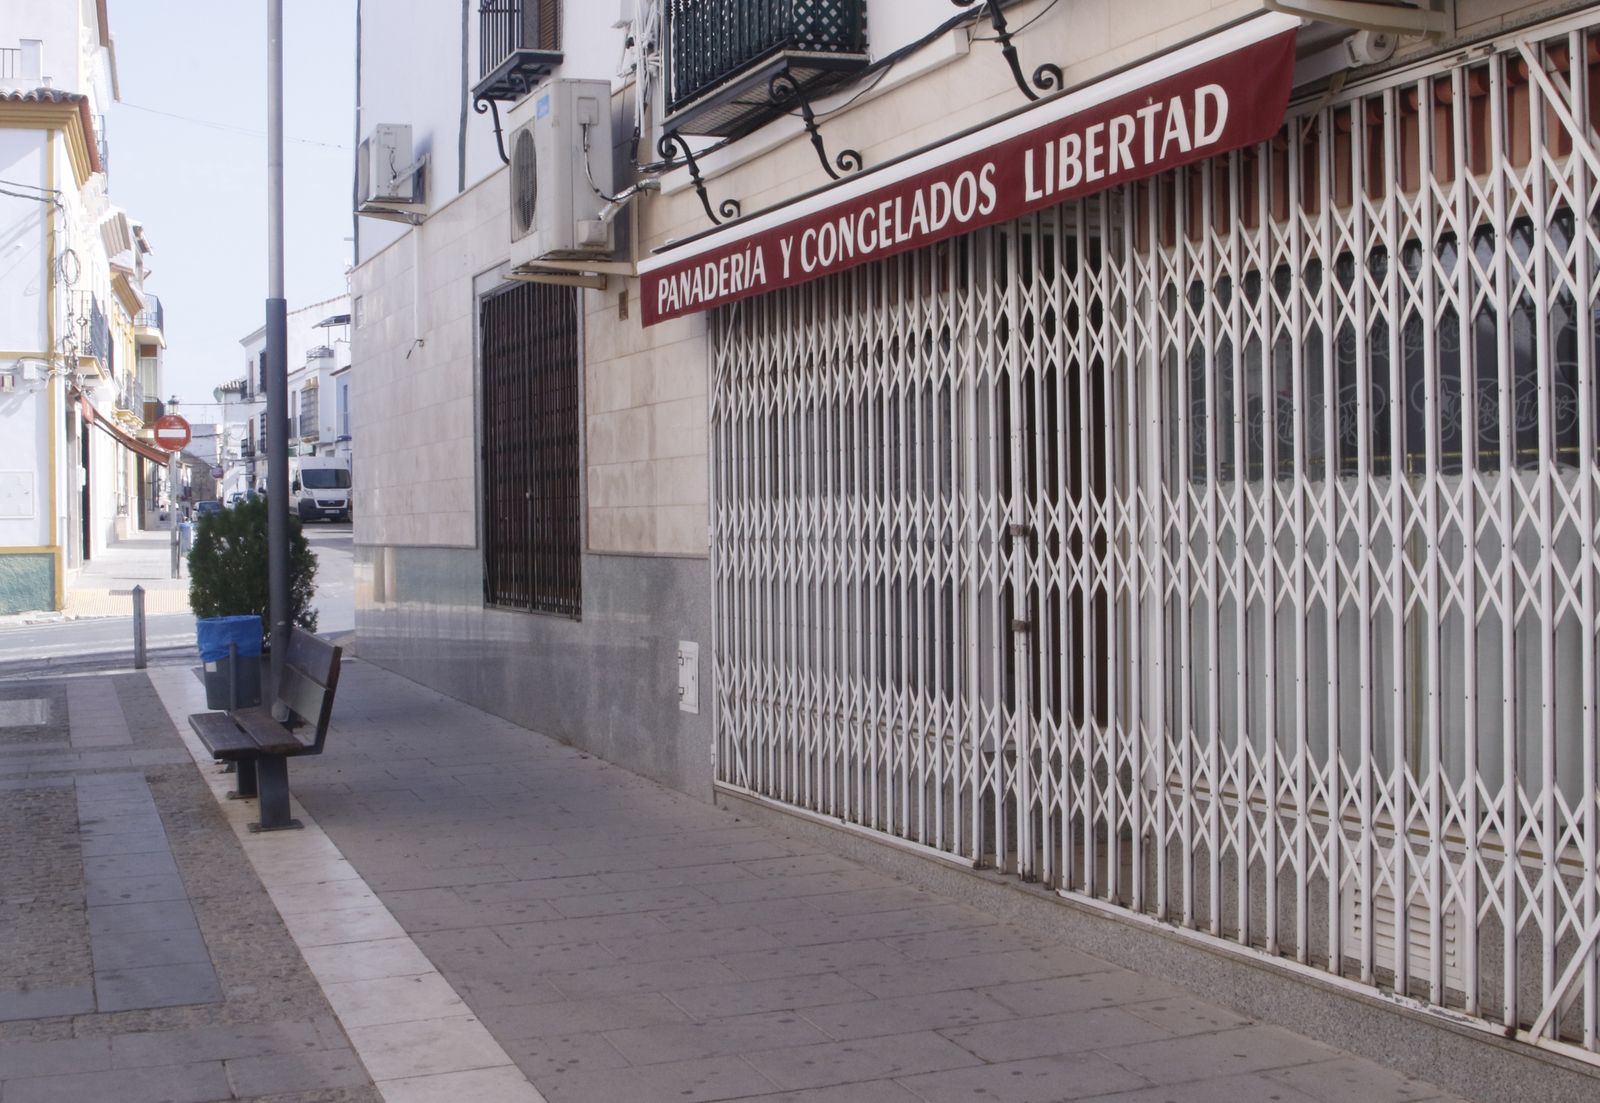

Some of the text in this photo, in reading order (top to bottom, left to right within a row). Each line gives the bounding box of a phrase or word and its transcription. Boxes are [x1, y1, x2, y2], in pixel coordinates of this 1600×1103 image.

[658, 83, 1229, 314] PANADERÍA Y CONGELADOS LIBERTAD
